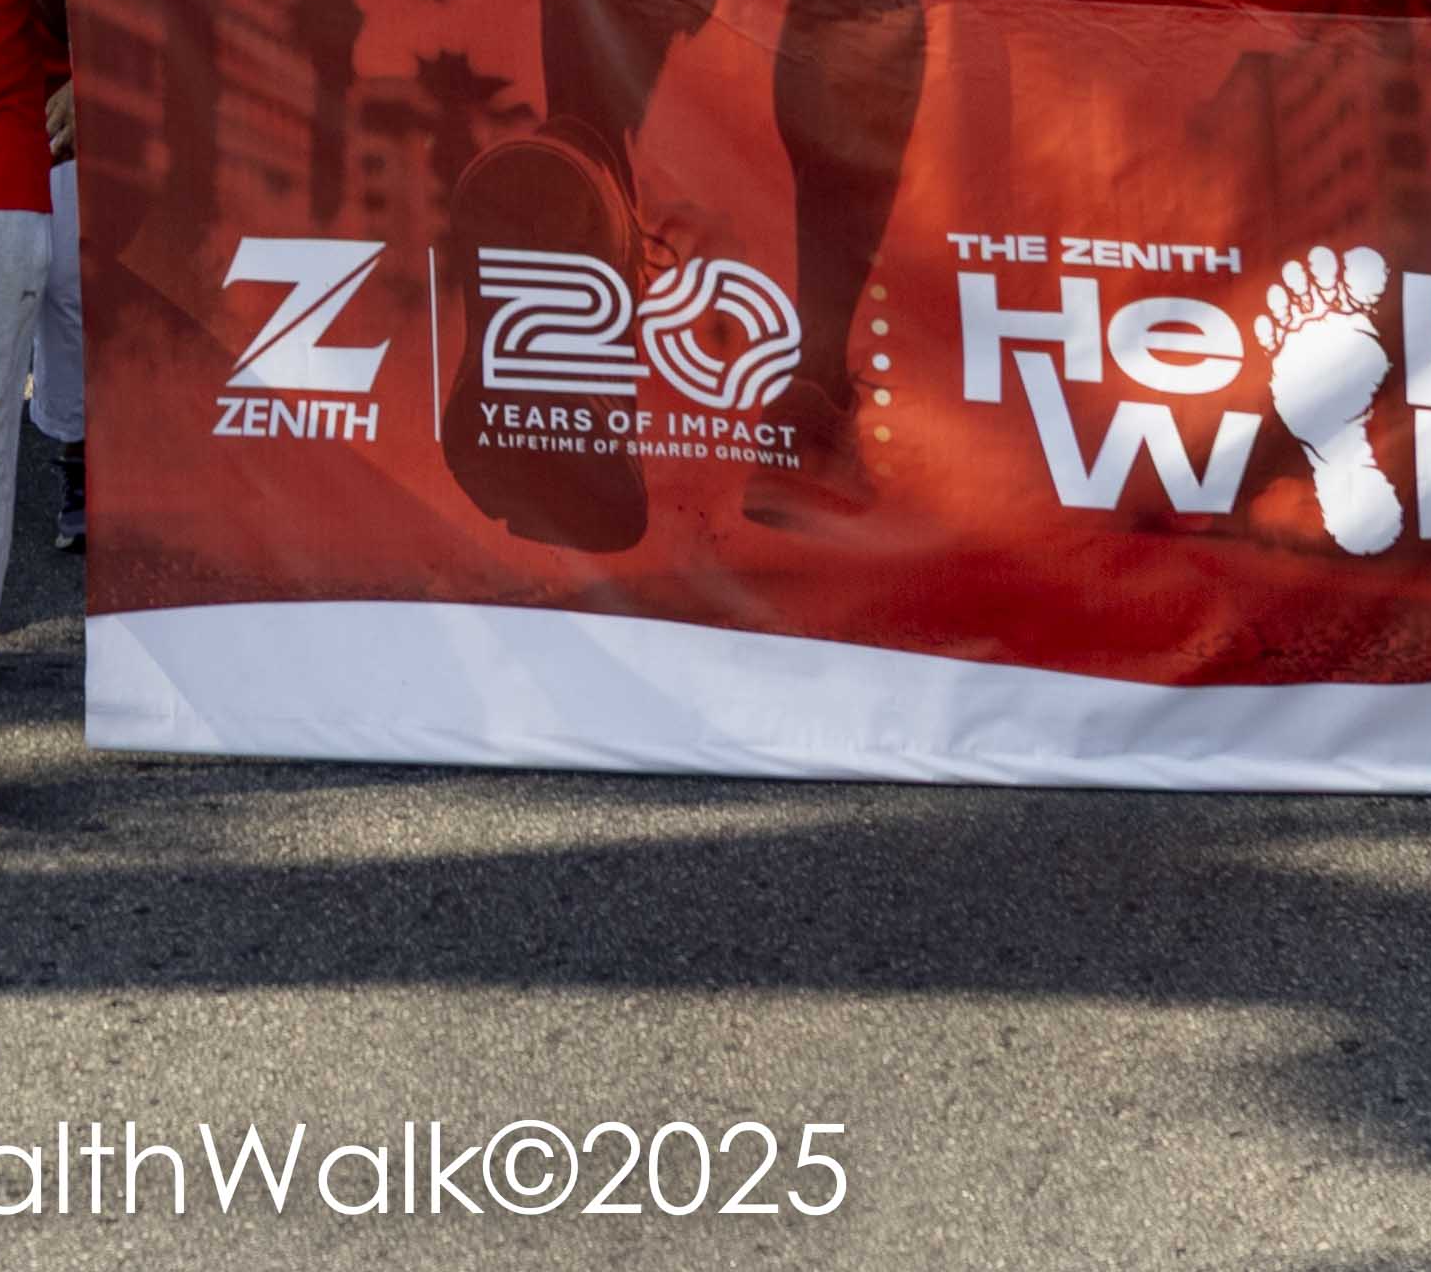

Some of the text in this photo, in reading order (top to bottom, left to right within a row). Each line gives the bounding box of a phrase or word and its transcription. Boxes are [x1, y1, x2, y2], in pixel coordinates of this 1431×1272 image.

[947, 232, 1242, 274] THE ZENITH
[222, 236, 390, 394] Z
[478, 247, 802, 411] 20
[212, 396, 380, 442] ZENITH
[480, 402, 797, 449] YEARS OF IMPACT
[478, 431, 801, 469] A LIFETIME OF SHARED GROWTH
